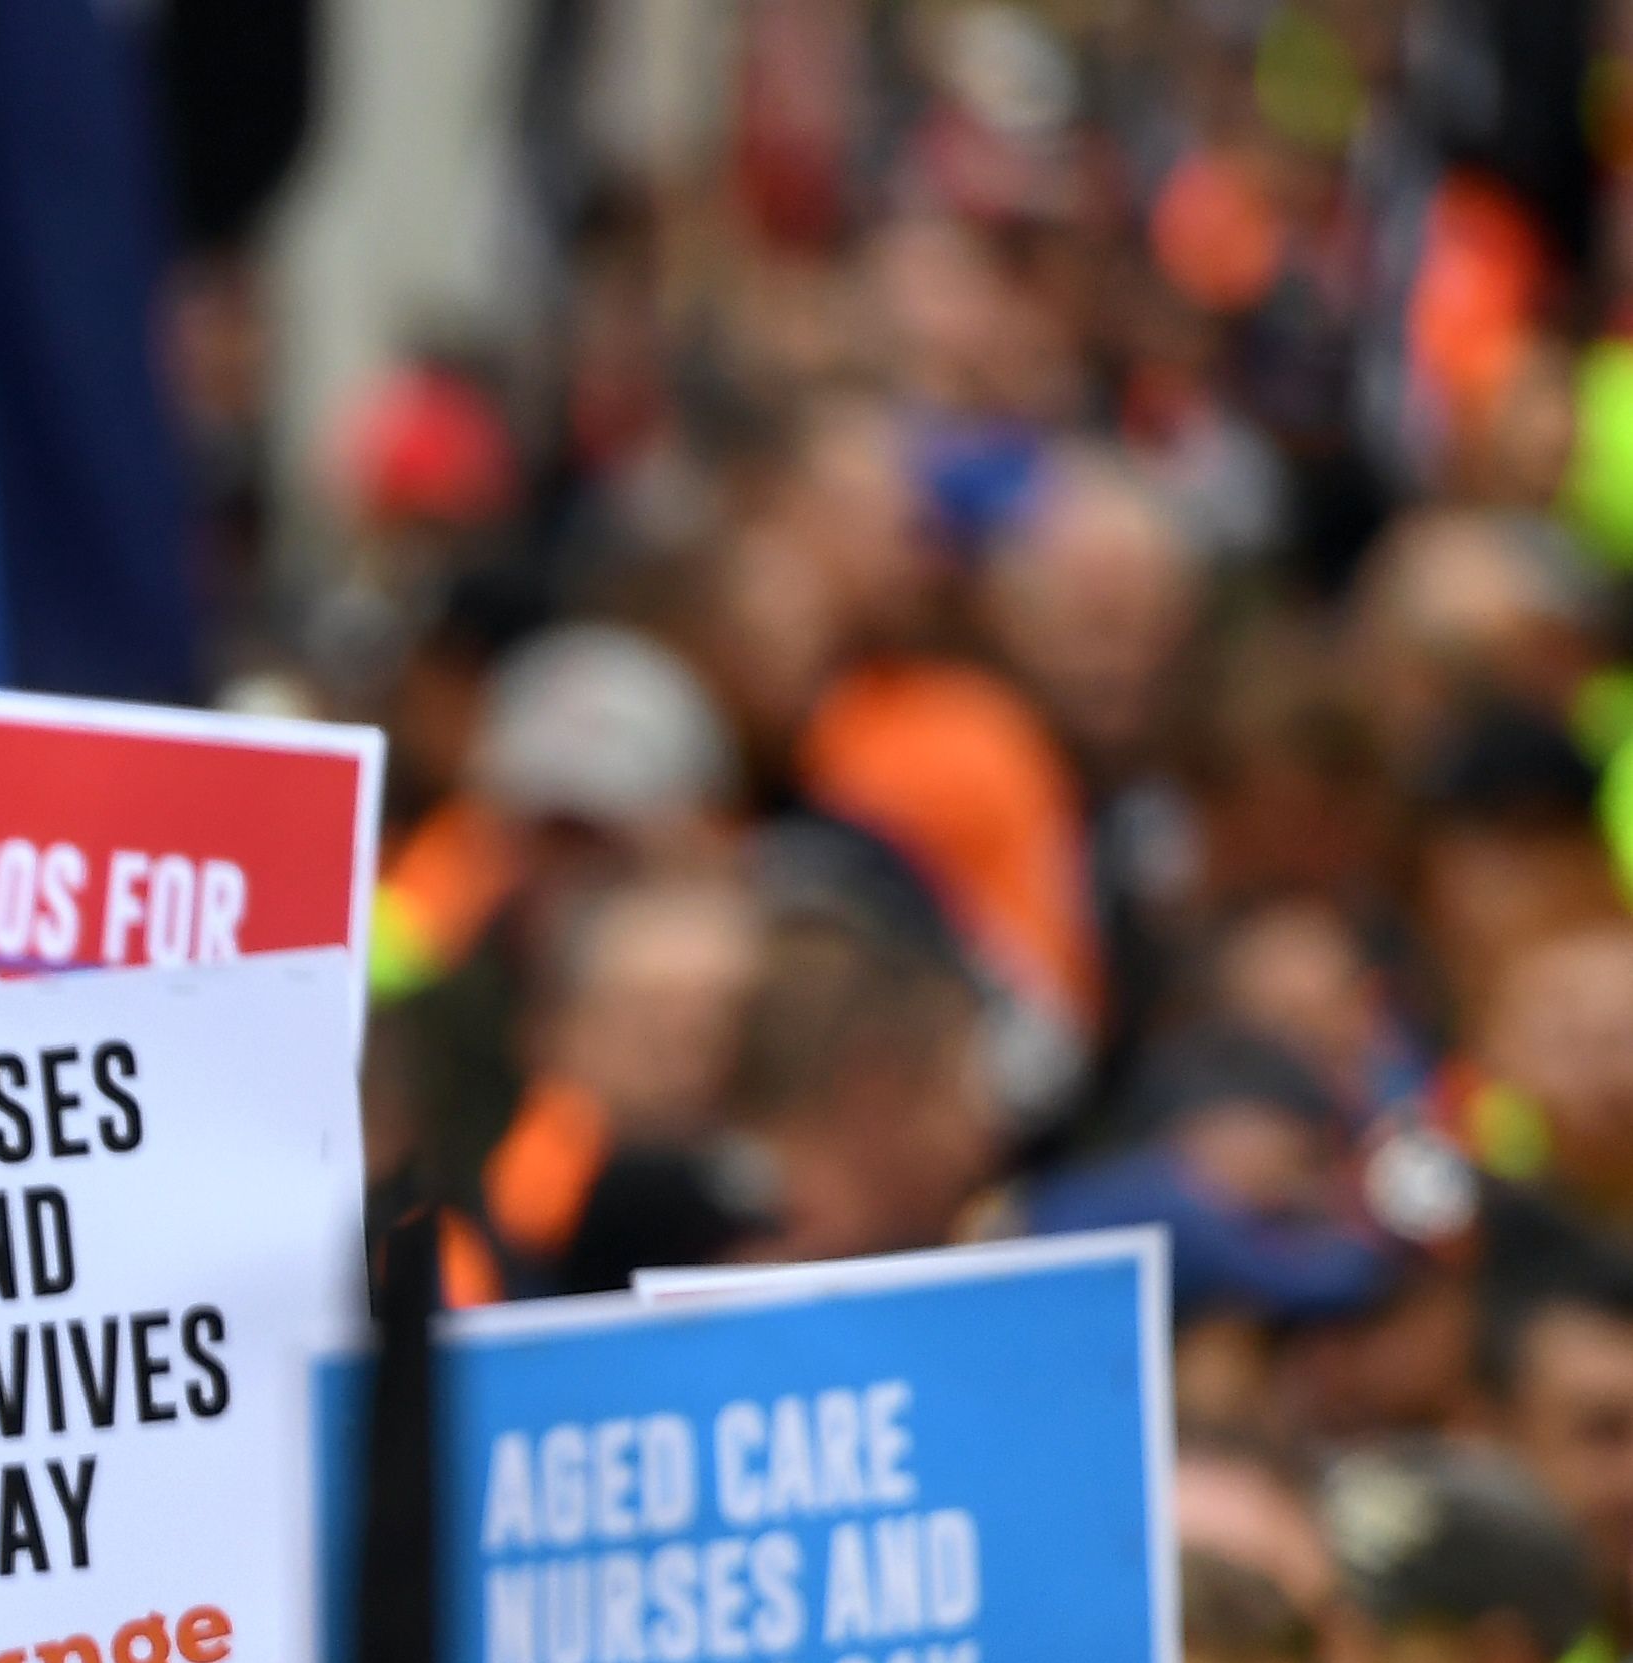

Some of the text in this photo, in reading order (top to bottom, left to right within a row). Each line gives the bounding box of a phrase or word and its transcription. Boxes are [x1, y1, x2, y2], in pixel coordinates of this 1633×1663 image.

[101, 848, 248, 965] FOR
[482, 1379, 917, 1553] AGED CARE
[824, 1508, 981, 1647] AND
